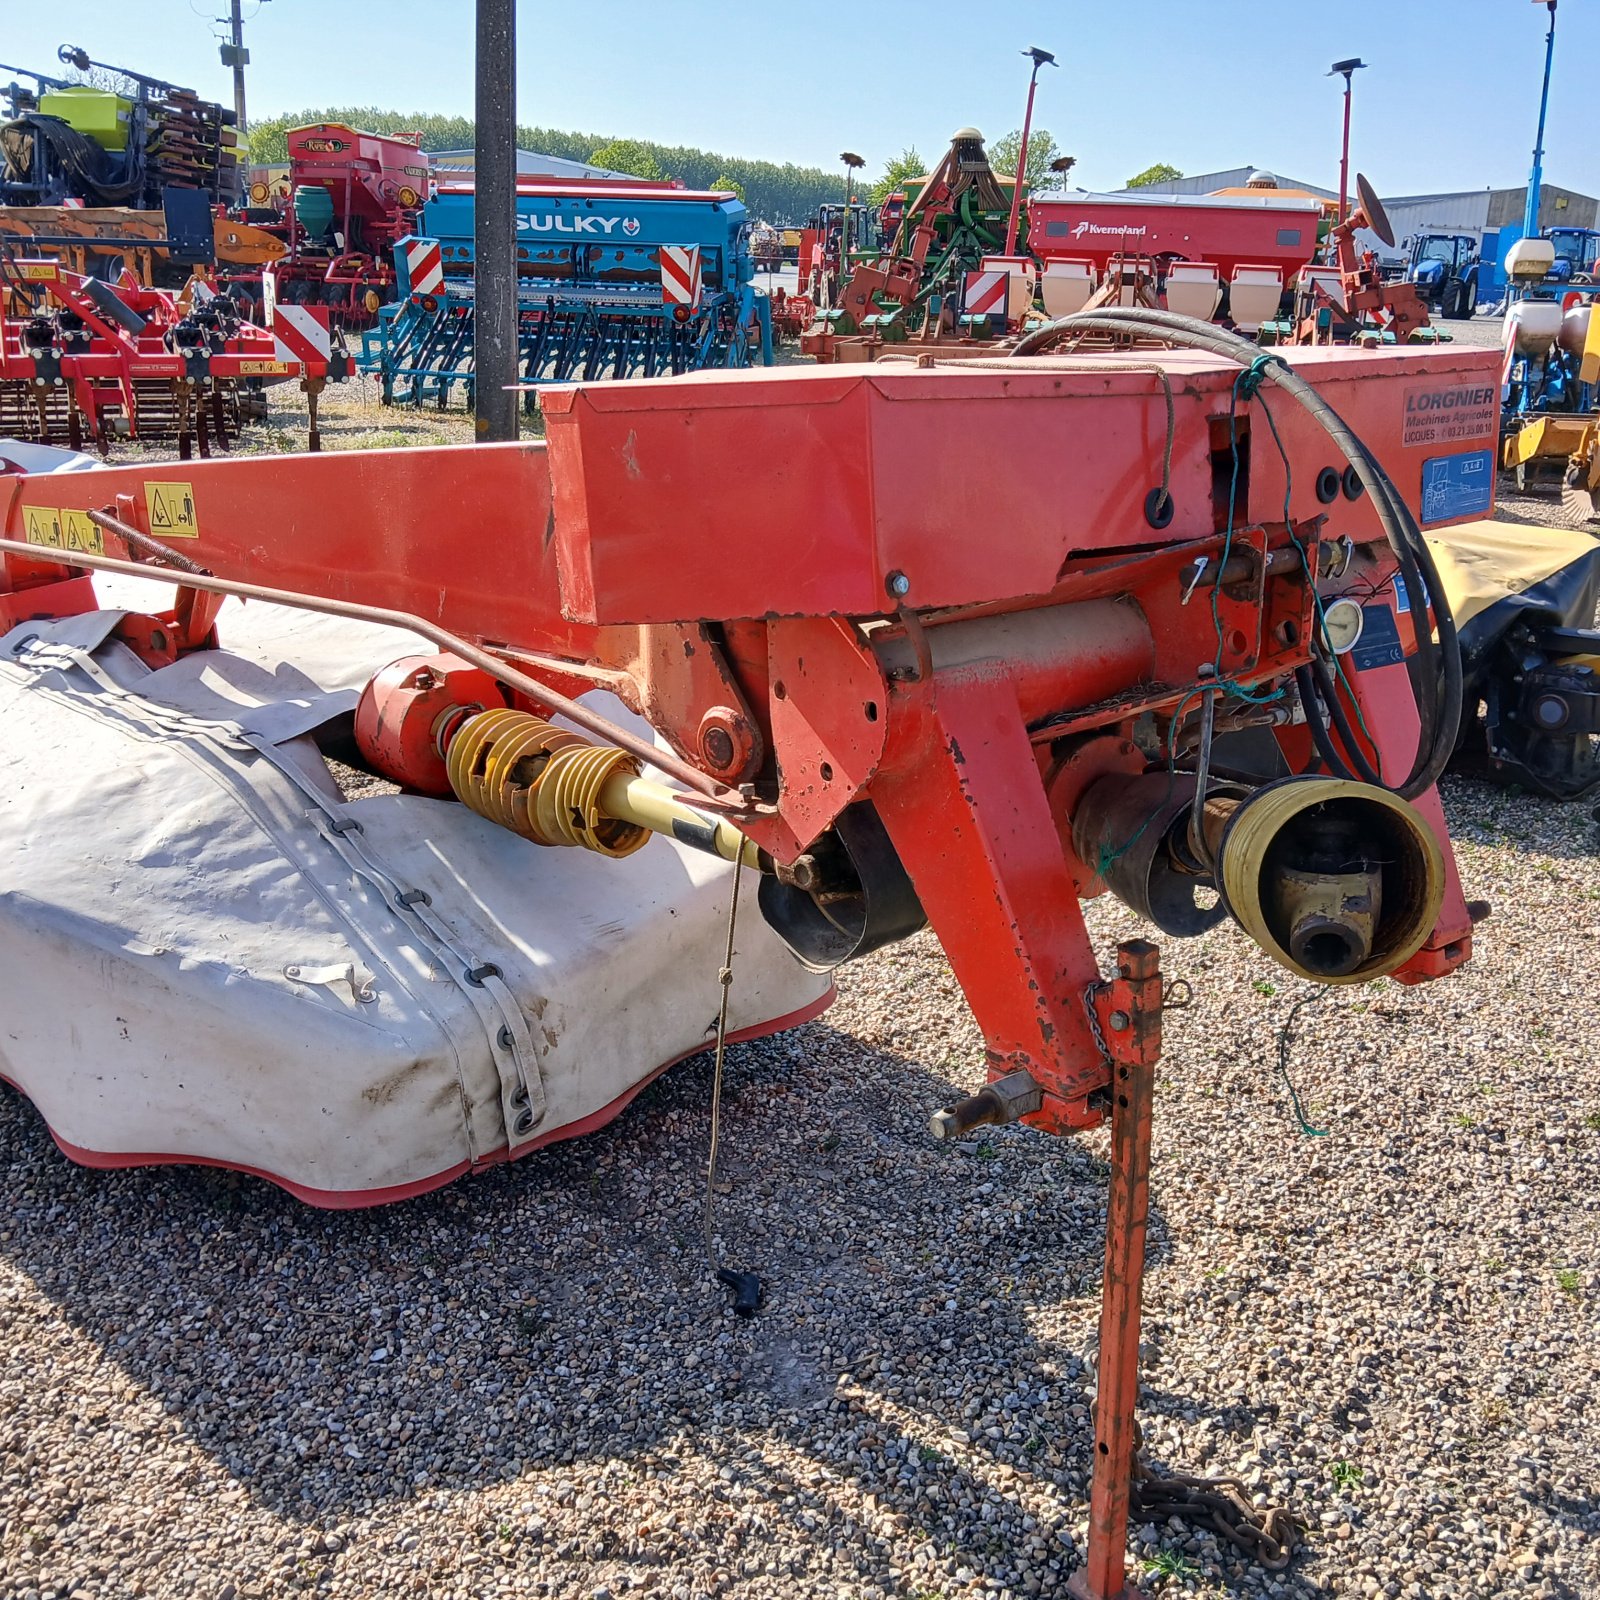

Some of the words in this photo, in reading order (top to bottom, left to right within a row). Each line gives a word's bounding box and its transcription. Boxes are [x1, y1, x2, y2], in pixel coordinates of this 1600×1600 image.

[517, 214, 621, 233] SULKY
[1089, 224, 1146, 235] Kverneland
[1407, 388, 1494, 412] LORGNIER
[1406, 413, 1450, 427] Machines
[1452, 409, 1493, 424] Agricoles
[1404, 429, 1435, 442] LICQUES
